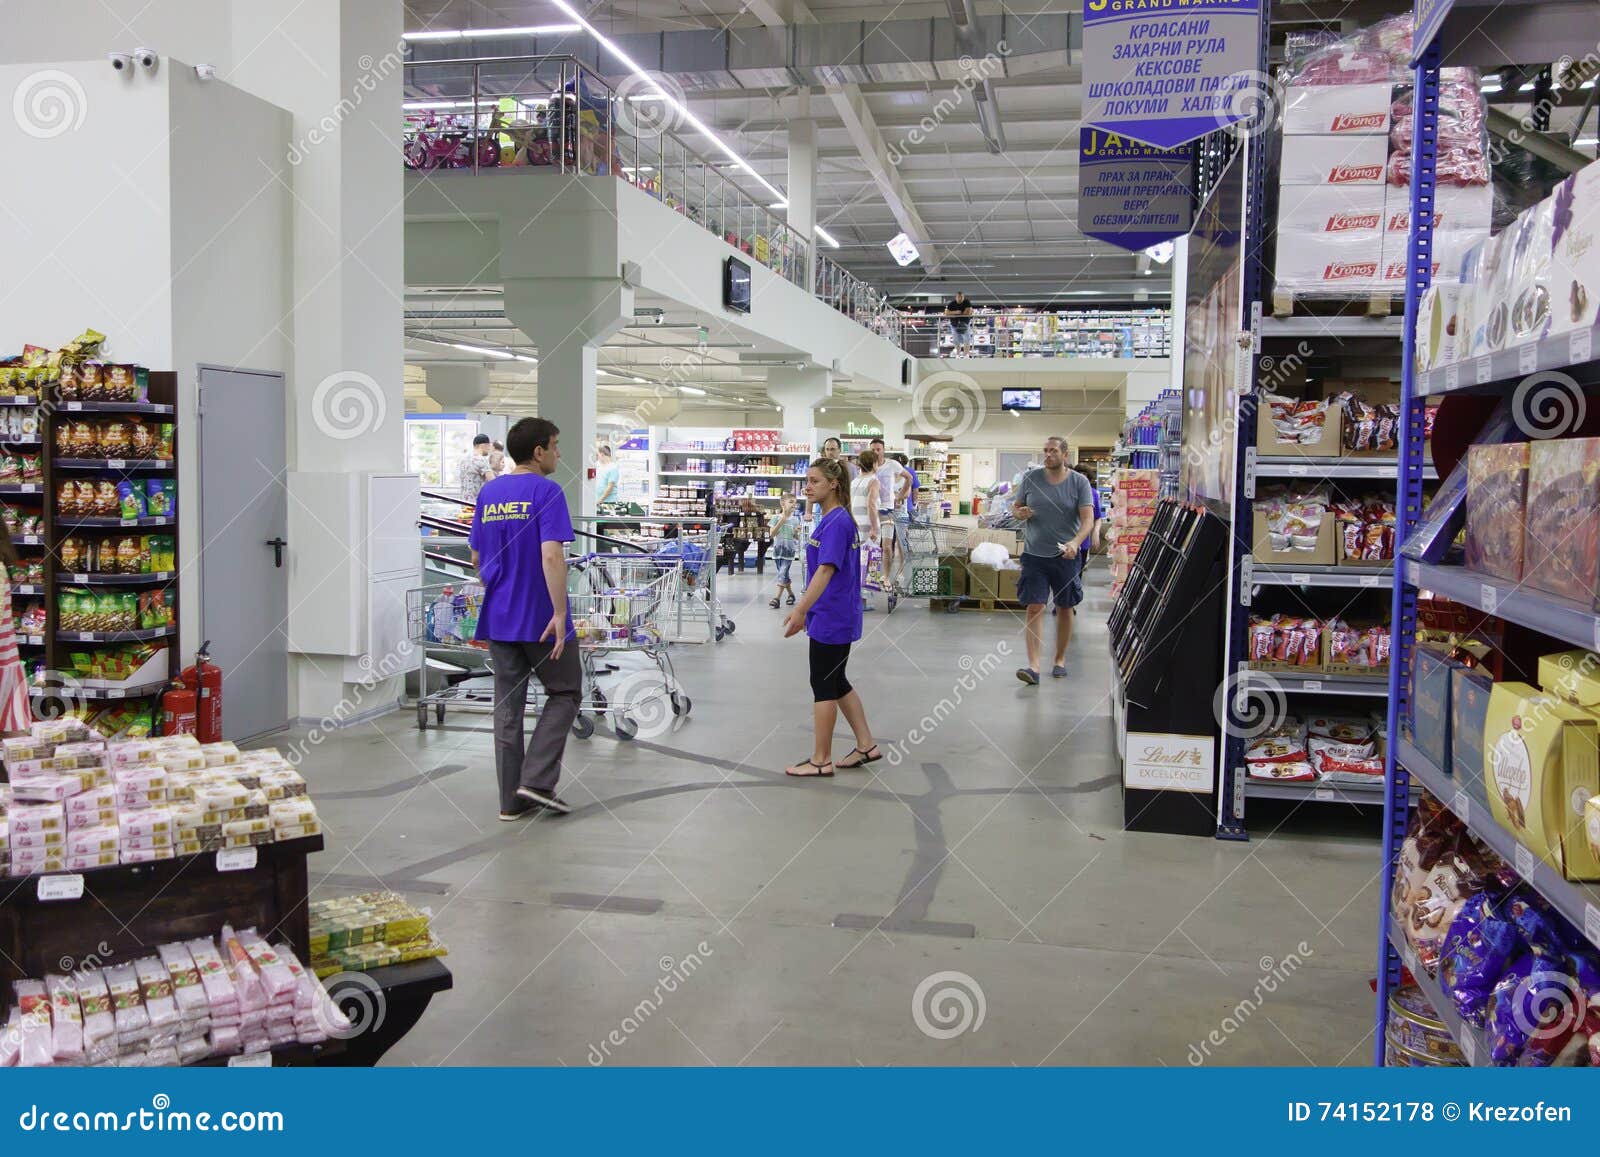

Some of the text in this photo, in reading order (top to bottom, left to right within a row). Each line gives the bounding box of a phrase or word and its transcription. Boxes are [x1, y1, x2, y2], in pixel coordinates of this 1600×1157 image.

[1129, 20, 1210, 40] КРОАСАНИ
[1112, 38, 1225, 60] ЗАХАРНИ РУЛА
[1135, 58, 1203, 77] КЕКСОВЕ
[1088, 75, 1249, 99] ШОКОЛАДОВИ ПАСТИ
[1103, 95, 1233, 117] ЛОКУМИ ХАЛВИ
[1336, 113, 1381, 130] Kronos
[1099, 148, 1140, 156] GRAND
[1098, 171, 1125, 182] ПРАХ
[1128, 171, 1140, 182] ЗА
[1334, 164, 1379, 181] Kronos
[1083, 186, 1131, 197] ПЕРИЛНИ
[1123, 200, 1149, 211] ВЕРО
[1092, 214, 1180, 225] ОБЕЗМАСЛИТЕЛИ
[1332, 213, 1376, 230] Kronos
[1329, 261, 1374, 279] Kronos
[481, 501, 532, 523] JANET
[1138, 746, 1188, 763] Lindt
[1139, 769, 1203, 781] EXCELLENCE
